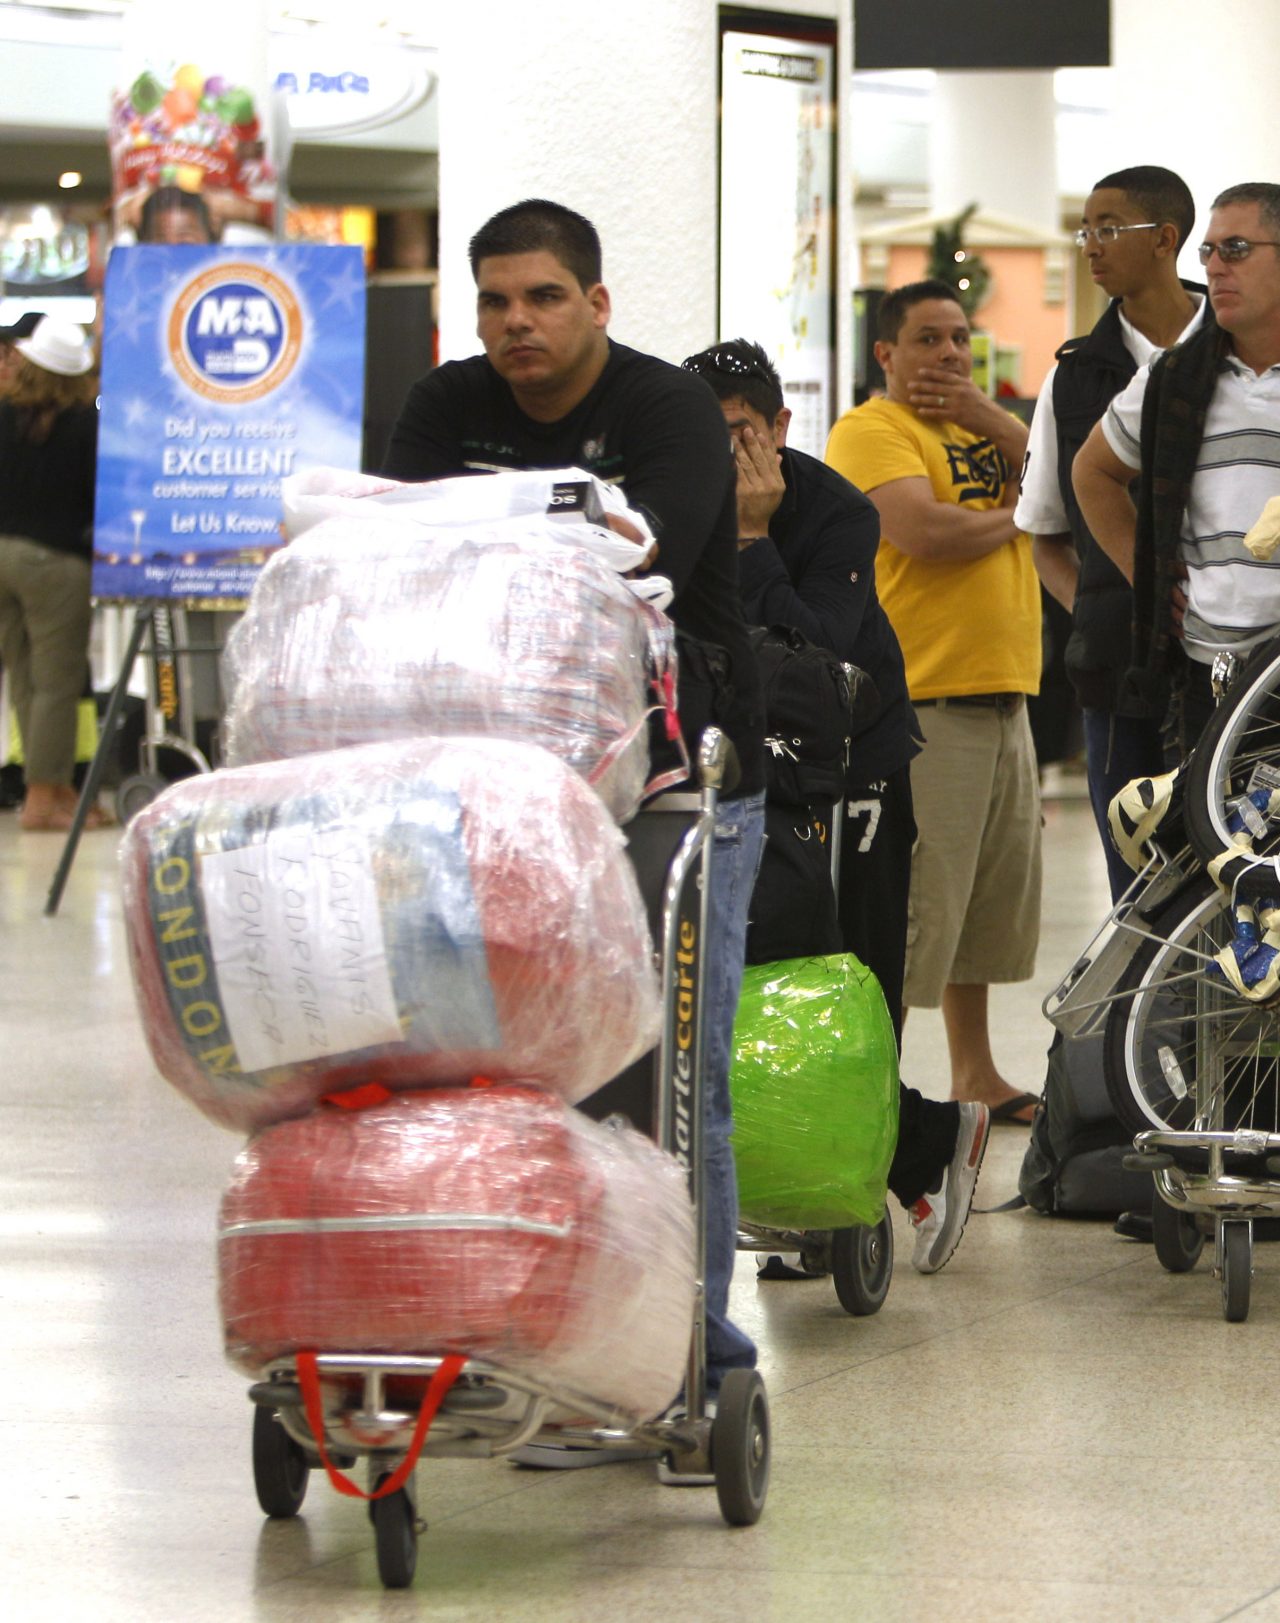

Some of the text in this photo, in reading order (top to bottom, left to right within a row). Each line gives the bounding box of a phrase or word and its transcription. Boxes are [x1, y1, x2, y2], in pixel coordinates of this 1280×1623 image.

[165, 418, 297, 443] Did you receive
[162, 448, 297, 476] EXCELLENT
[152, 480, 283, 498] customer servic
[171, 510, 279, 534] Let Us Know.
[847, 798, 882, 853] 7
